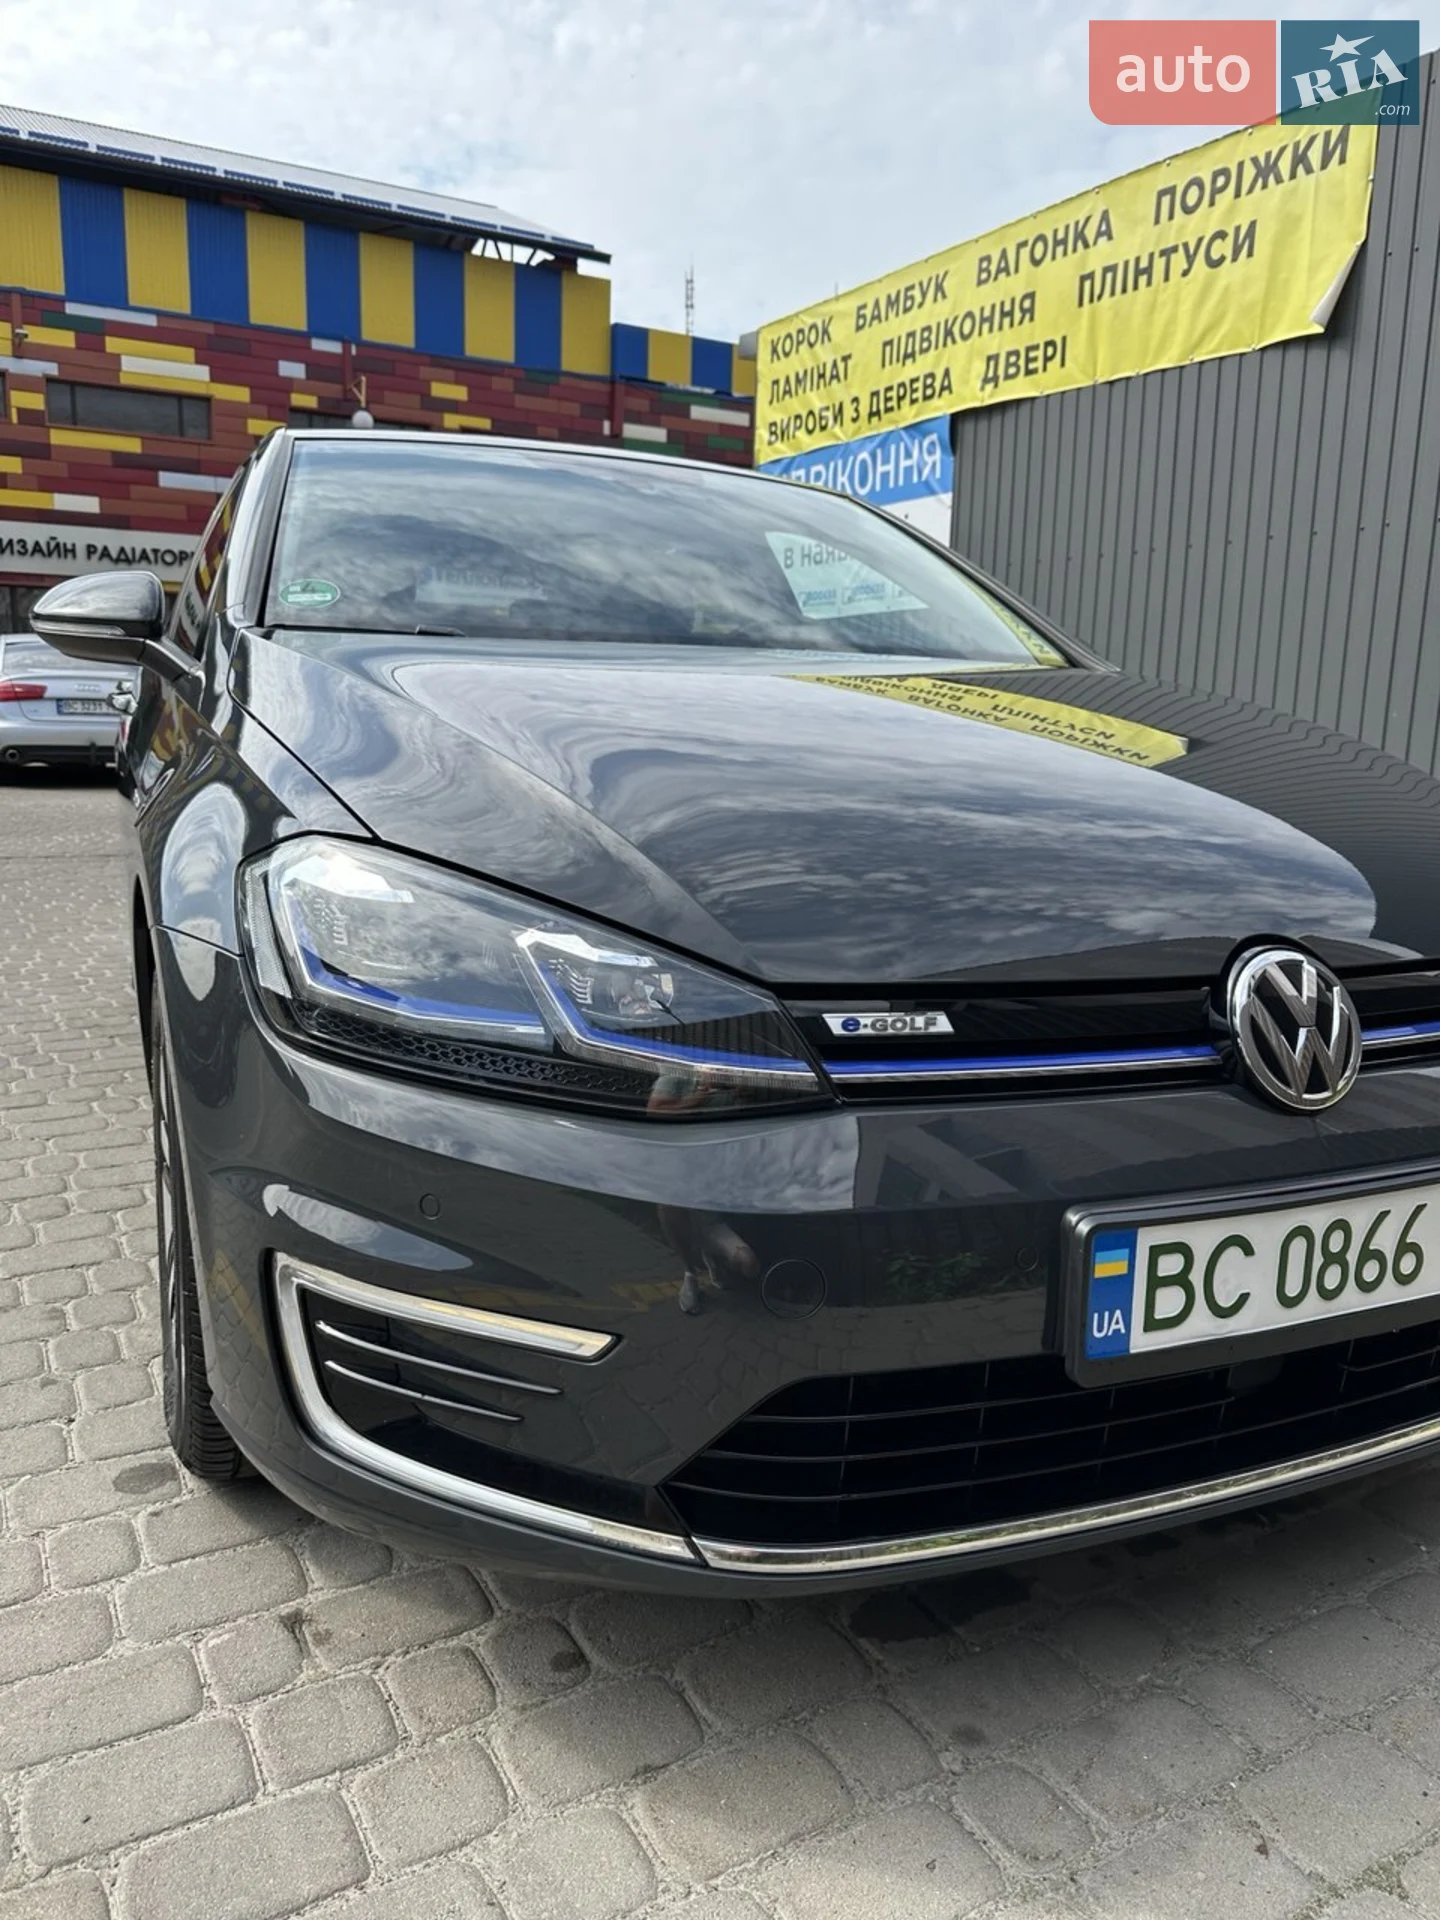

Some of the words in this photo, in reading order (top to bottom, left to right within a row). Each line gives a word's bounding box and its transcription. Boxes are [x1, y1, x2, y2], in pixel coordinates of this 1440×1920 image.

[769, 315, 834, 364] КОРОК
[855, 270, 949, 333] БАМБУК
[976, 208, 1114, 288] ВАГОНКА
[1153, 124, 1350, 226] ПОРІЖКИ
[768, 353, 853, 406] ЛАМІНАТ
[881, 291, 1036, 369] ПІДВІКОННЯ
[1077, 219, 1258, 308] ПЛІНТУСИ
[768, 401, 844, 446] ВИРОБИ
[867, 367, 953, 424] ДЕРЕВА
[980, 335, 1067, 392] ДВЕРІ
[780, 433, 942, 496] ВІКОННЯ
[1092, 1309, 1126, 1339] UA
[1143, 1233, 1256, 1333] BC
[1276, 1202, 1428, 1309] 0866
